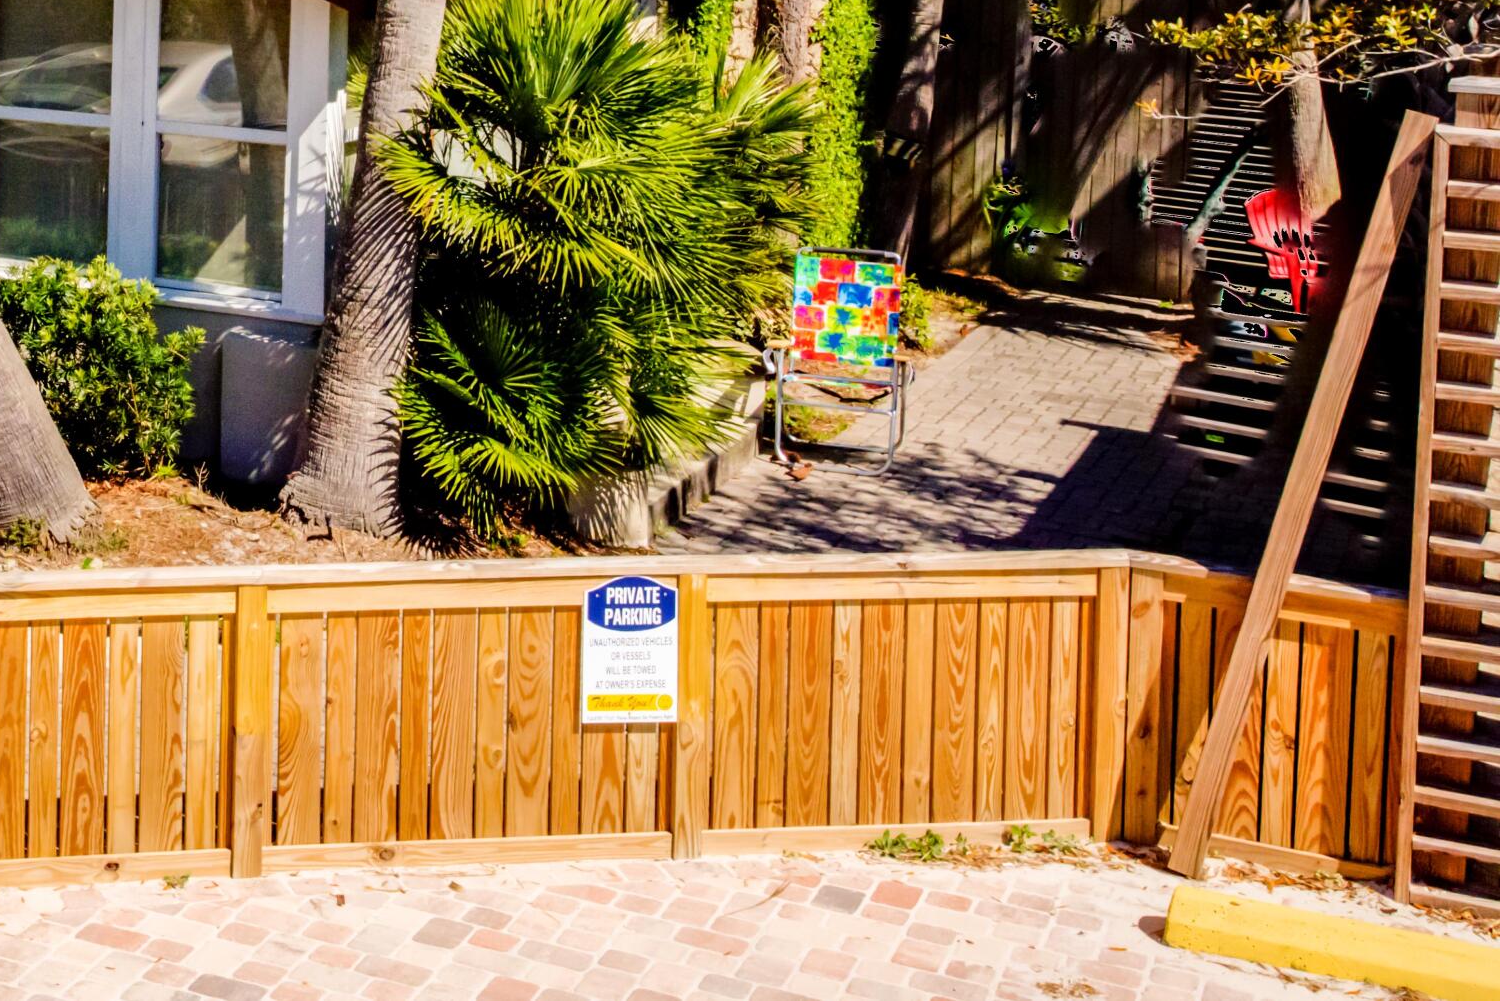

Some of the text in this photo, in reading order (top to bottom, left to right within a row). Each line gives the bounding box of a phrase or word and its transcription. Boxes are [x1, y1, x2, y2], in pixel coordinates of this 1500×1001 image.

[606, 586, 660, 605] PRIVATE
[604, 607, 662, 626] PARKING
[589, 637, 673, 648] UNAUTHORIZED VEHICLES
[611, 651, 651, 661] OR VESSELS
[606, 665, 656, 675] WILL BE TOWED
[595, 679, 666, 690] AT OWNER'S EXPENSE
[591, 696, 624, 709] Thank
